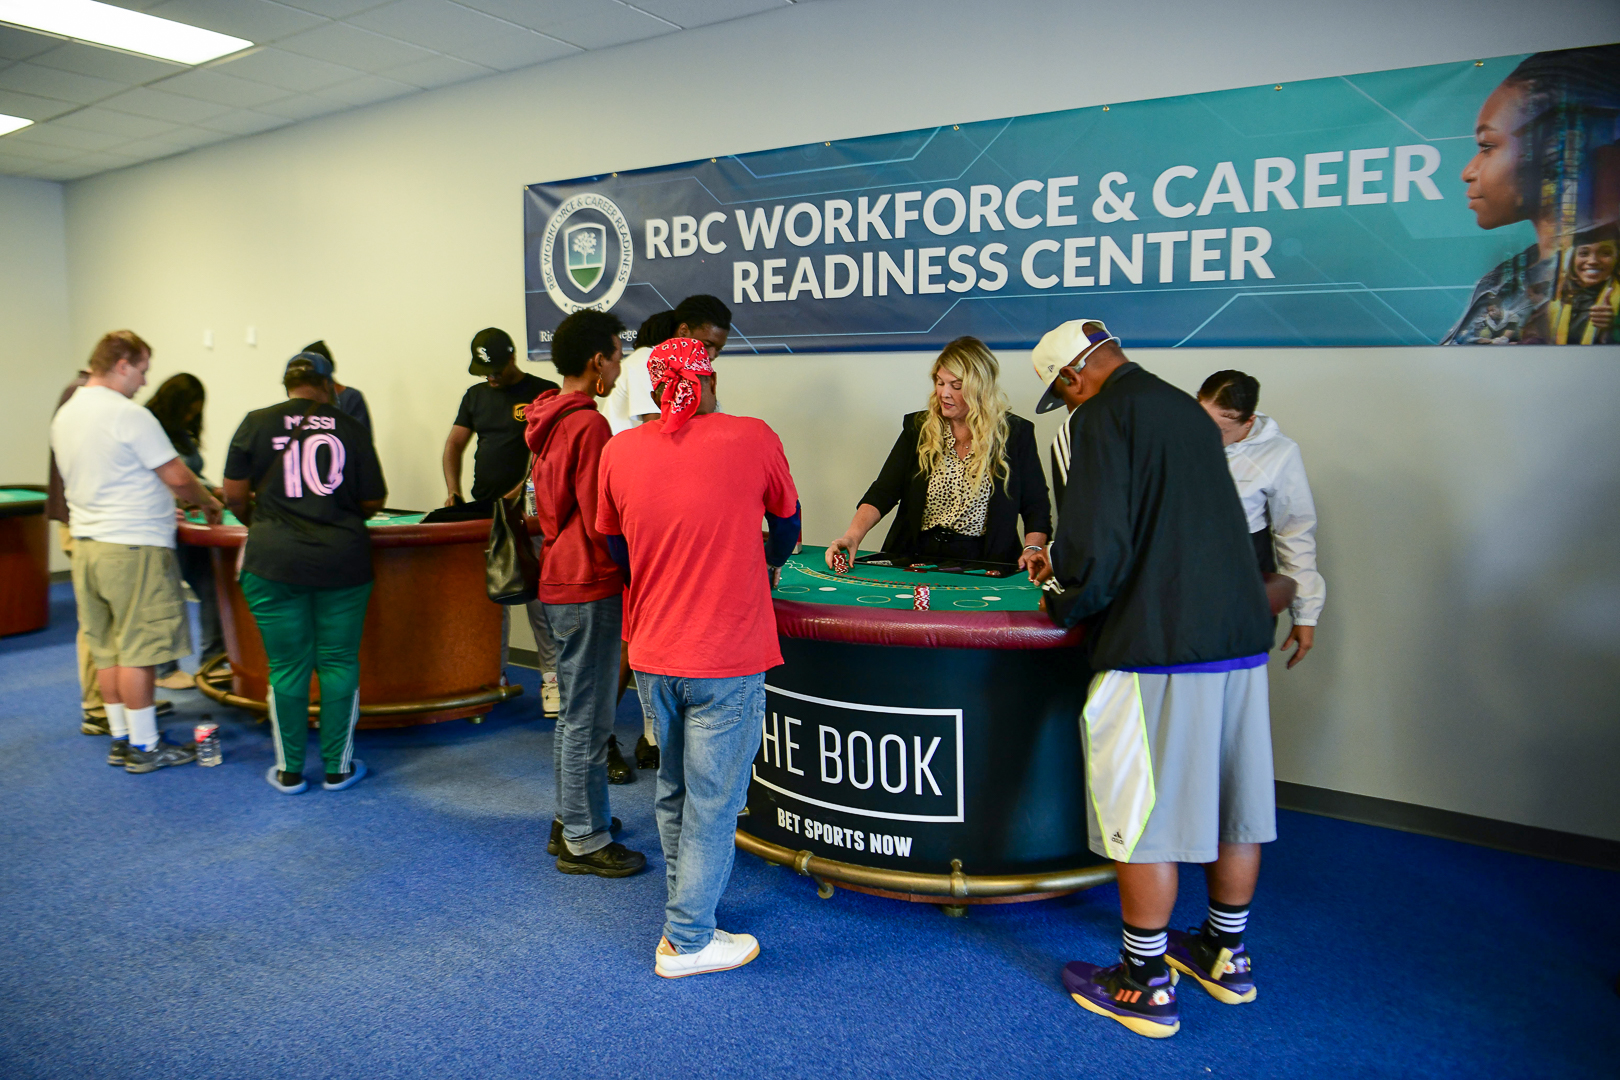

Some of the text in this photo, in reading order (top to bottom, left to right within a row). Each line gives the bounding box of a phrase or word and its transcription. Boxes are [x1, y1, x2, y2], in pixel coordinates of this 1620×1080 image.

[645, 144, 1444, 259] RBC WORKFORCE & CAREER
[544, 196, 631, 291] RBC WORKFORCE & CAREER READINESS
[733, 226, 1276, 304] READINESS CENTER
[271, 432, 346, 498] 10
[762, 712, 943, 796] HE BOOK
[777, 807, 913, 857] BET SPORTS NOW
